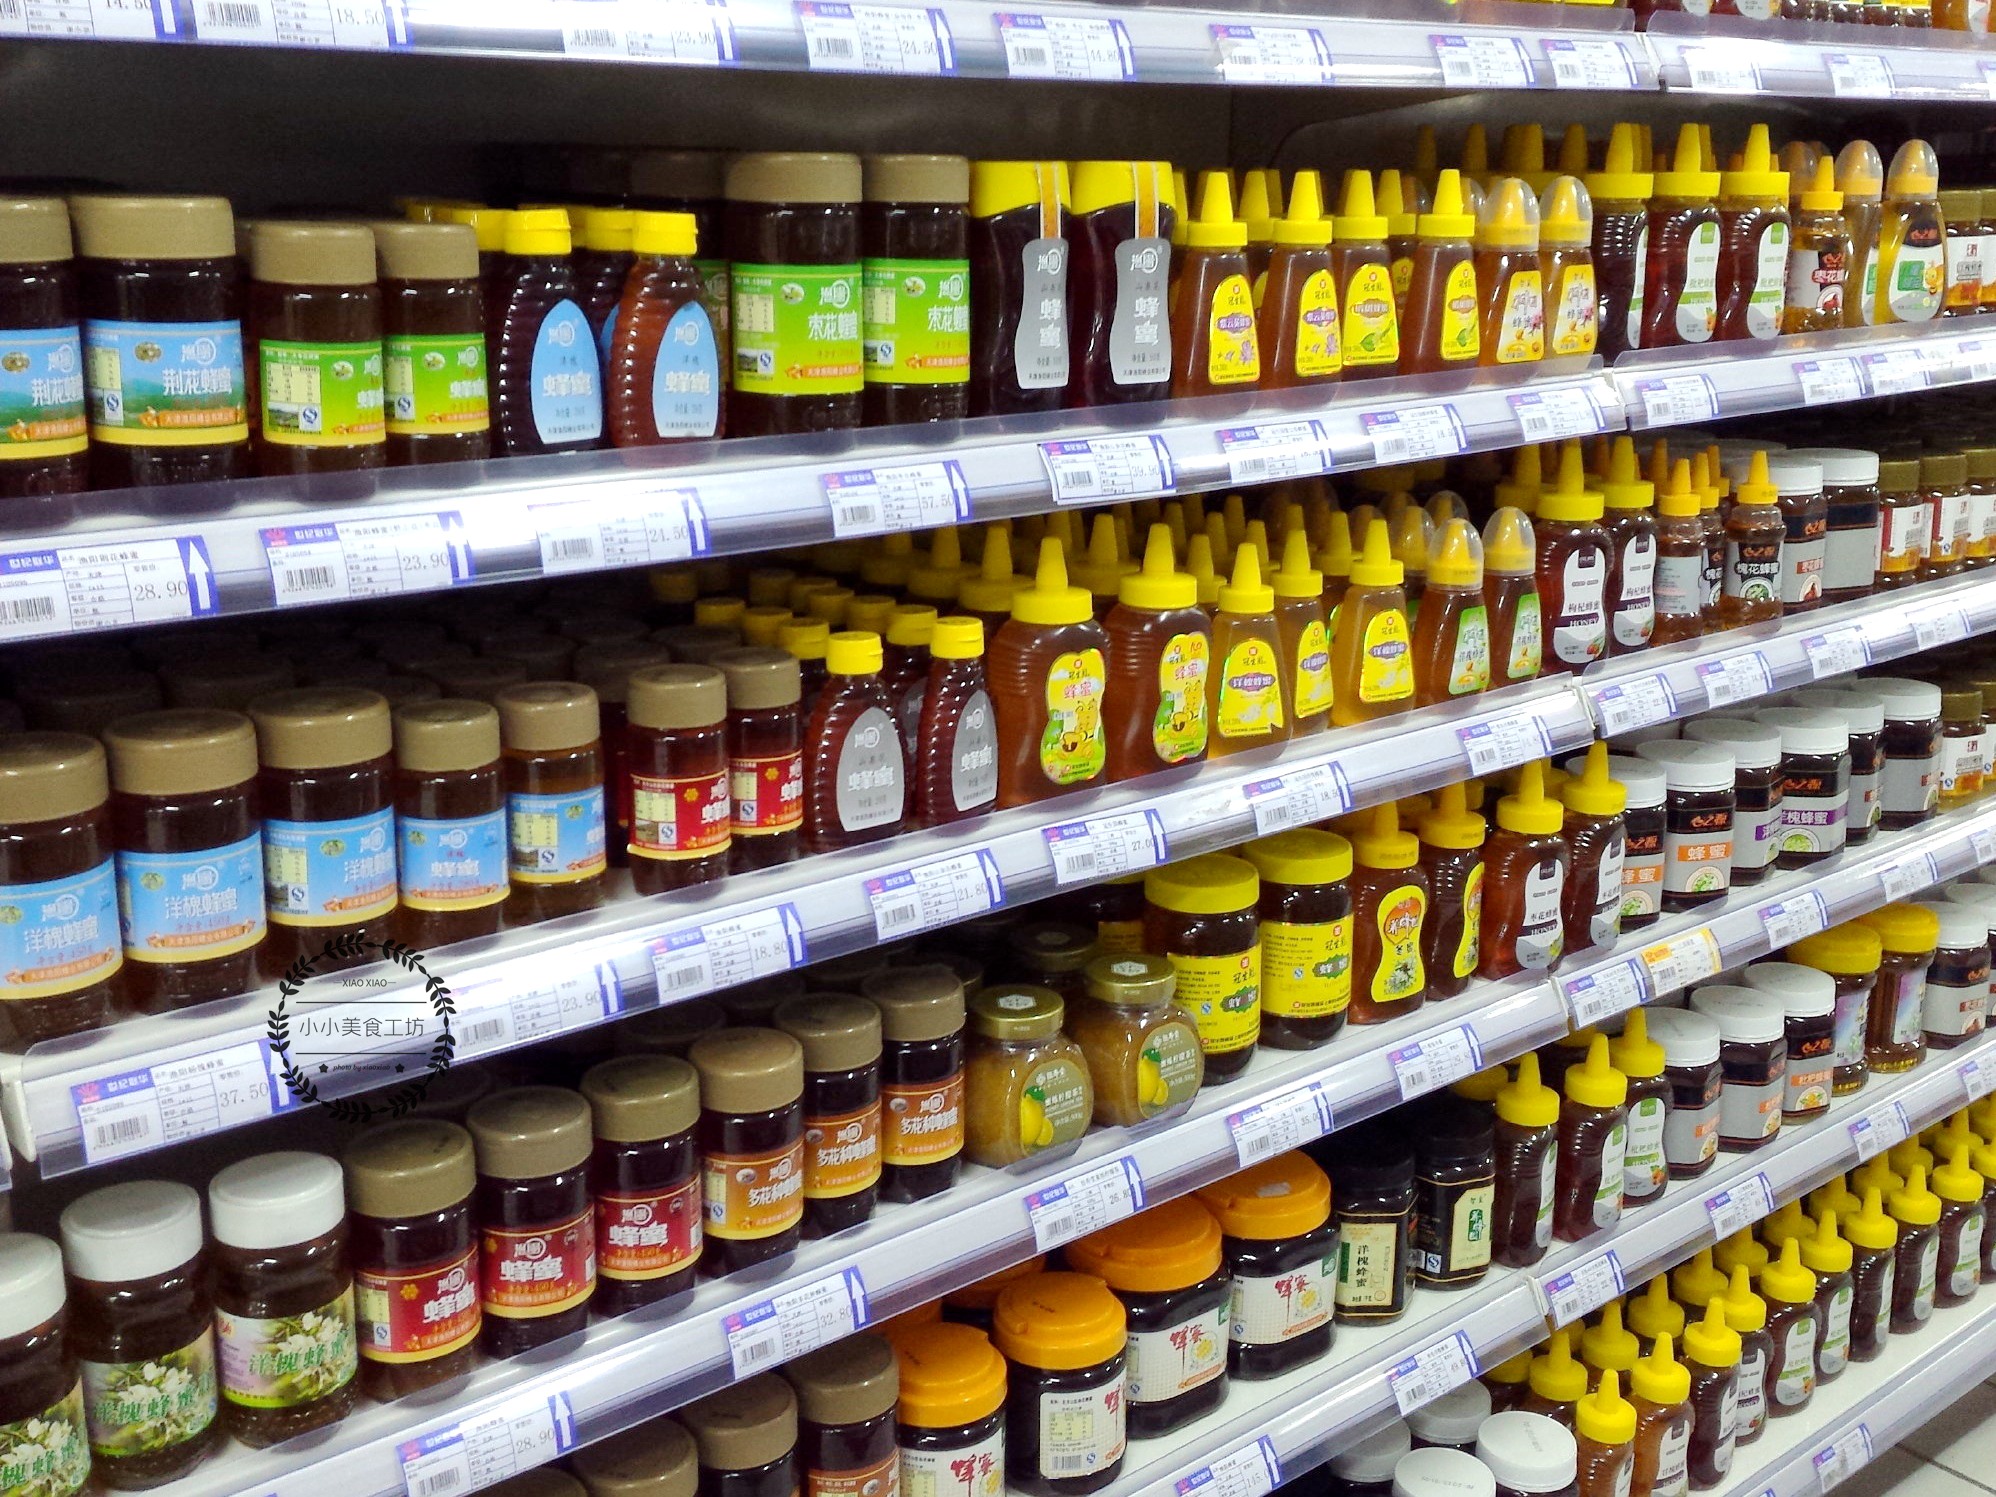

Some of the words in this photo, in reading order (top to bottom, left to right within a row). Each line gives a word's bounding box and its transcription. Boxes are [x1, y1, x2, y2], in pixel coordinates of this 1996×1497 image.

[402, 552, 449, 572] 23.90
[134, 579, 188, 602] 28.90
[1568, 616, 1600, 628] HONEY
[1174, 662, 1199, 681] 蜂蜜
[1063, 681, 1092, 699] 蜂蜜
[1687, 843, 1727, 861] 蜂蜜
[164, 888, 238, 920] 洋槐蜂蜜
[219, 1081, 269, 1109] 37.50
[608, 1220, 669, 1247] 蜂蜜
[500, 1254, 564, 1282] 蜂蜜
[1356, 1244, 1369, 1288] 洋槐蜂蜜
[422, 1281, 476, 1324] 蜂蜜
[248, 1329, 349, 1375] 洋槐蜂蜜
[94, 1386, 193, 1424] 洋槐蜂蜜
[515, 1427, 555, 1454] 28.90
